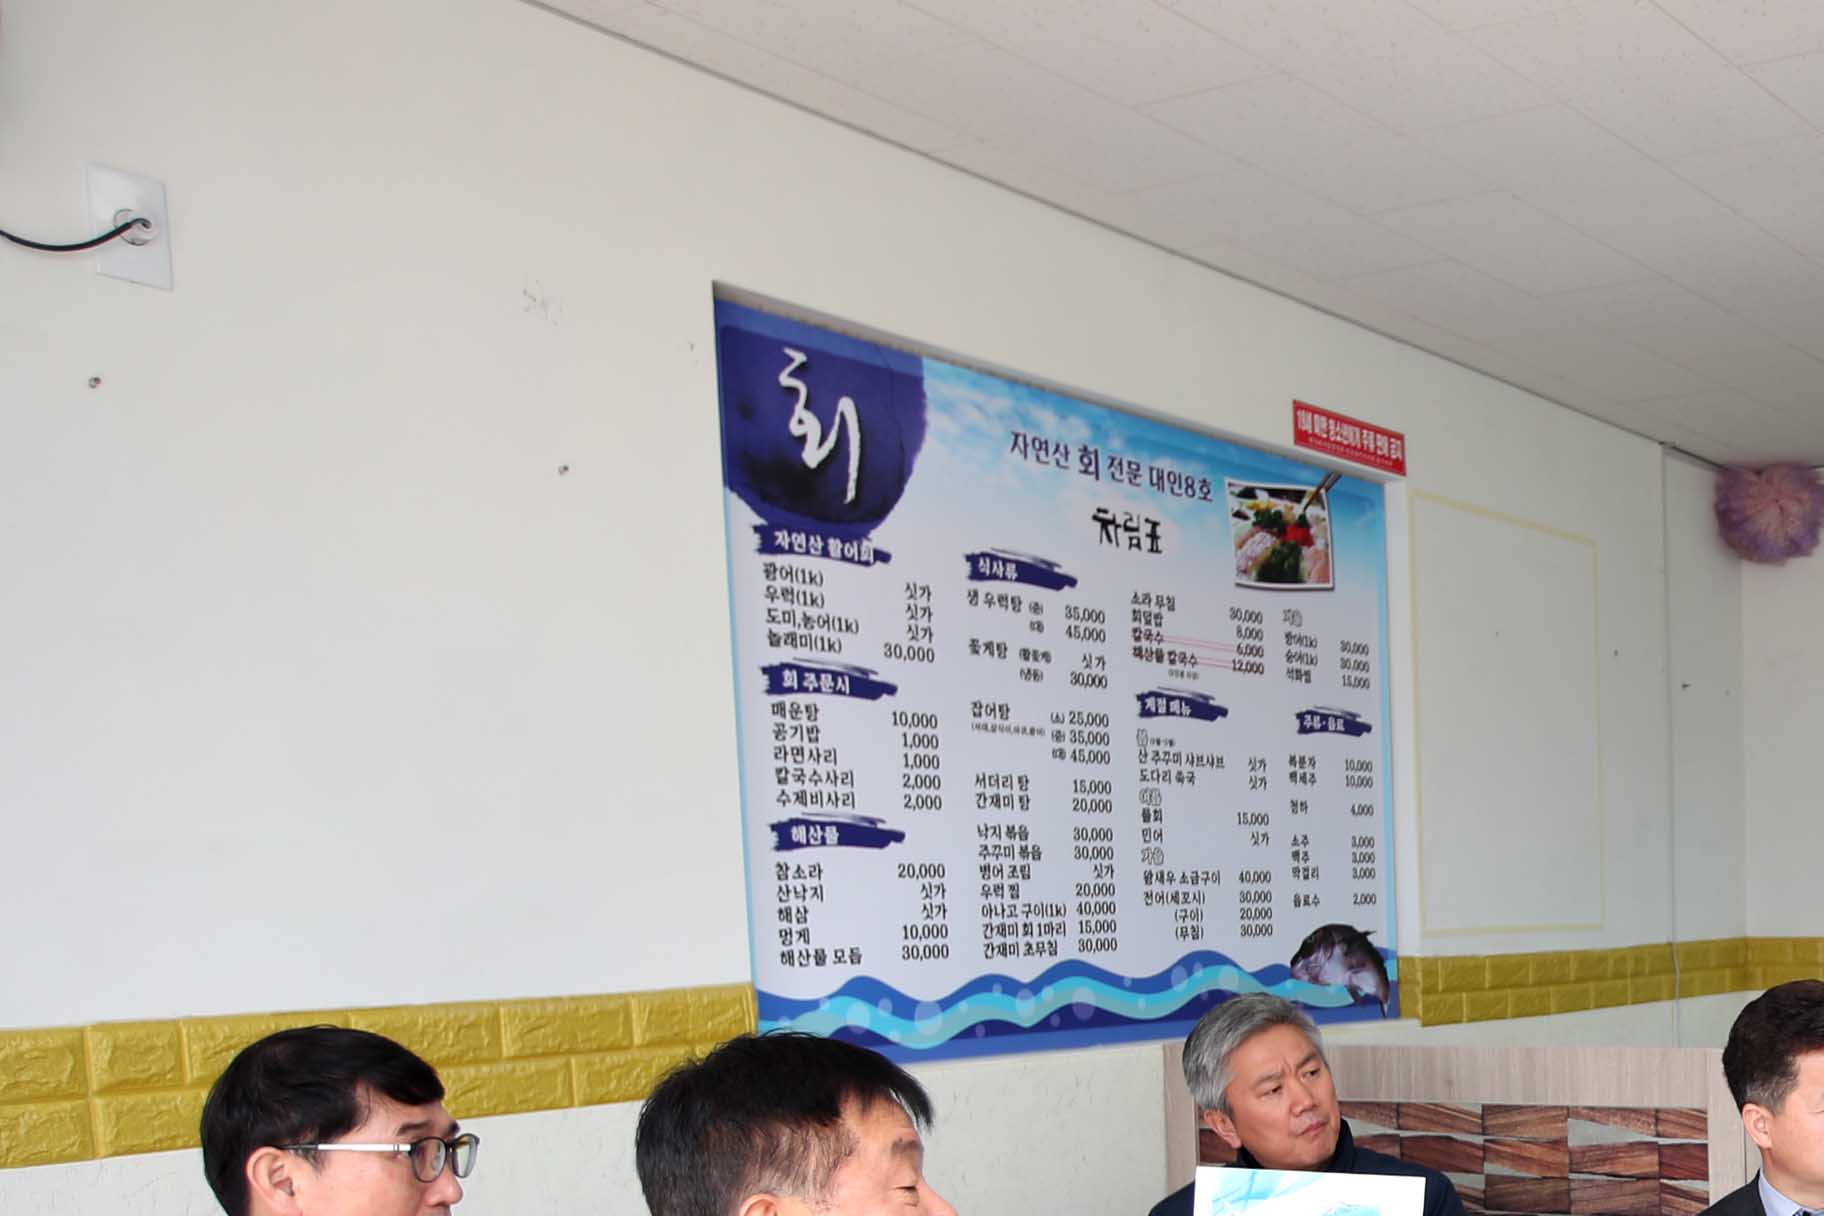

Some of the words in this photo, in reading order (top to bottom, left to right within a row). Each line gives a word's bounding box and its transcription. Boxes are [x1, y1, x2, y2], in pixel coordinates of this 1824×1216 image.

[779, 347, 860, 504] 회
[1010, 430, 1071, 470] 자연산
[1078, 446, 1100, 481] 회
[1107, 455, 1144, 487] 전문
[1149, 465, 1214, 502] 대인8호
[1092, 507, 1163, 554] 차림표
[774, 530, 823, 555] 자연산
[978, 557, 1018, 581] 식사류
[763, 561, 824, 587] 광어(1k)
[905, 581, 932, 602] 싯가
[764, 584, 825, 608] 우럭(1k)
[906, 603, 933, 622] 싯가
[967, 589, 979, 606] 생
[984, 591, 1022, 614] 우럭탕
[1065, 605, 1105, 624] 35,000
[1131, 591, 1152, 608] 소라
[1156, 594, 1175, 612] 무침
[1230, 606, 1263, 624] 30,000
[907, 624, 933, 643] 싯가
[1065, 625, 1106, 643] 45,000
[1132, 608, 1163, 628] 회덮밥
[1236, 625, 1263, 642] 8,000
[767, 628, 842, 653] 놀래미(1k)
[884, 642, 935, 663] 30,000
[1132, 626, 1164, 645] 칼국수
[1236, 642, 1264, 658] 6,000
[1340, 640, 1369, 656] 30,000
[969, 638, 1008, 659] 꽃게탕
[1082, 652, 1106, 671] 싯가
[1232, 658, 1264, 676] 12,000
[1340, 657, 1370, 673] 30,000
[782, 669, 798, 691] 회
[803, 673, 850, 695] 주문시
[1070, 671, 1108, 689] 30,000
[1342, 674, 1370, 690] 15,000
[771, 701, 819, 722] 매운탕
[892, 711, 938, 729] 10,000
[971, 700, 1010, 721] 잡어탕
[1069, 711, 1109, 727] 25,000
[772, 722, 820, 743] 공기밥
[902, 732, 939, 750] 1,000
[1070, 730, 1110, 746] 35,000
[774, 744, 837, 765] 라면사리
[903, 753, 940, 769] 1,000
[1070, 749, 1111, 765] 45,000
[1138, 748, 1148, 764] 산
[1248, 756, 1267, 773] 싯가
[1345, 759, 1373, 773] 10,000
[775, 766, 854, 787] 칼국수사리
[903, 774, 941, 791] 2,000
[974, 772, 1013, 790] 서더리
[1018, 774, 1029, 791] 탕
[1073, 779, 1112, 795] 15,000
[1139, 768, 1172, 784] 도다리
[1249, 775, 1268, 791] 싯가
[1289, 770, 1317, 786] 백세주
[1346, 775, 1374, 789] 10,000
[776, 789, 855, 808] 수제비사리
[904, 794, 942, 811] 2,000
[976, 792, 1014, 810] 간재미
[1019, 794, 1030, 811] 탕
[1073, 798, 1113, 814] 20,000
[1290, 799, 1308, 815] 청하
[1351, 804, 1374, 817] 4,000
[1237, 811, 1269, 826] 15,000
[790, 824, 839, 845] 해산물
[977, 823, 1002, 841] 낙지
[1006, 824, 1029, 841] 볶음
[1073, 827, 1113, 842] 30,000
[1142, 827, 1163, 844] 민어
[1250, 831, 1270, 847] 싯가
[1291, 833, 1309, 847] 소주
[1352, 836, 1375, 849] 3,000
[978, 844, 1016, 861] 주꾸미
[1019, 844, 1042, 861] 볶음
[1074, 846, 1114, 861] 30,000
[1291, 849, 1310, 864] 맥주
[1352, 852, 1375, 864] 3,000
[776, 862, 823, 881] 참소라
[898, 863, 945, 880] 20,000
[979, 864, 1004, 880] 병어
[1008, 863, 1031, 880] 조림
[1093, 862, 1114, 879] 싯가
[1144, 869, 1176, 886] 왕새우
[1179, 869, 1221, 886] 소금구이
[1238, 870, 1271, 884] 40,000
[1292, 865, 1319, 881] 막걸리
[1352, 867, 1376, 880] 3,000
[777, 883, 824, 902] 산낙지
[921, 882, 946, 900] 싯가
[980, 883, 1005, 900] 우럭
[1008, 883, 1020, 900] 찜
[1075, 883, 1115, 898] 20,000
[1240, 890, 1272, 904] 30,000
[1293, 893, 1320, 908] 음료수
[1353, 893, 1376, 906] 2,000
[778, 905, 808, 924] 해삼
[922, 902, 947, 920] 싯가
[982, 902, 1019, 919] 아나고
[1021, 901, 1067, 919] 구이(1k)
[1077, 901, 1116, 917] 40,000
[1174, 907, 1203, 923] (구이)
[1240, 907, 1272, 921] 20,000
[779, 927, 810, 946] 멍게
[902, 924, 949, 941] 10,000
[982, 922, 1019, 939] 간재미
[1022, 921, 1034, 937] 회
[1037, 921, 1066, 938] 1마리
[1078, 920, 1117, 935] 15,000
[1175, 924, 1204, 942] (무침)
[1240, 924, 1273, 938] 30,000
[781, 948, 827, 967] 해산물
[833, 947, 862, 966] 모듬
[902, 944, 950, 962] 30,000
[984, 941, 1020, 959] 간재미
[1023, 940, 1058, 957] 초무침
[1078, 938, 1118, 954] 30,000
